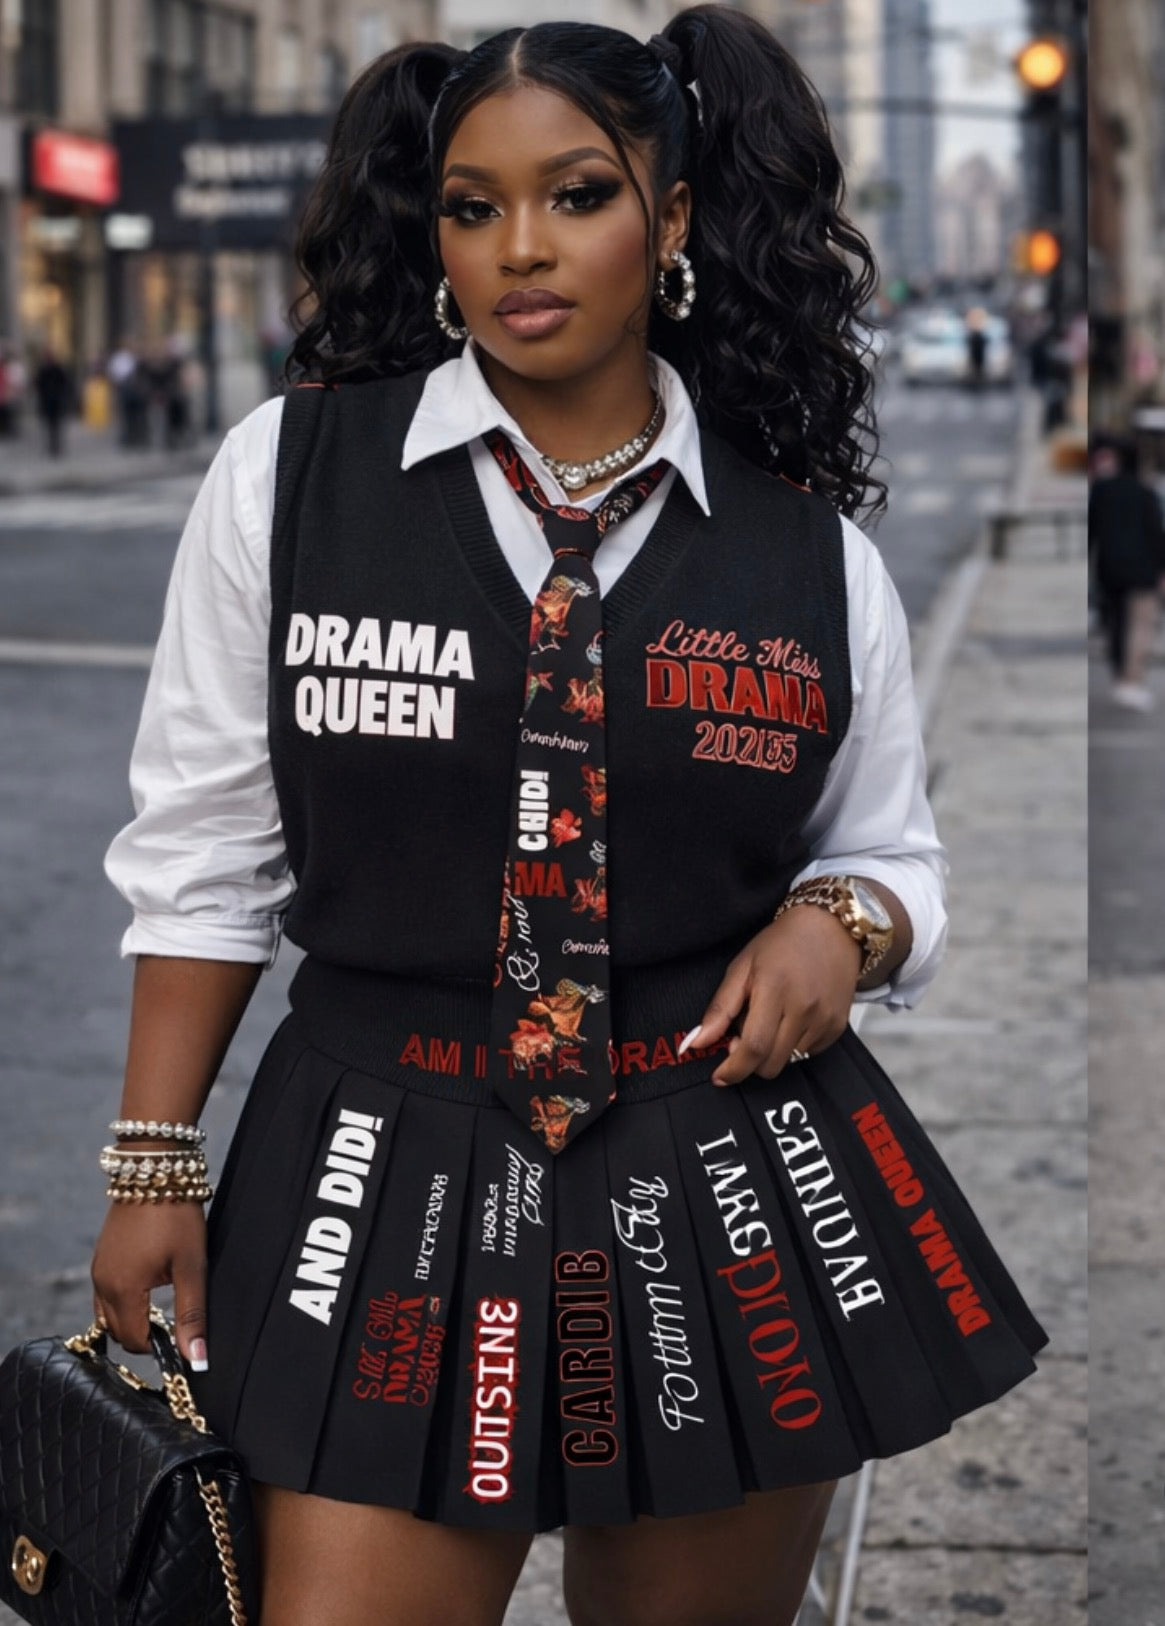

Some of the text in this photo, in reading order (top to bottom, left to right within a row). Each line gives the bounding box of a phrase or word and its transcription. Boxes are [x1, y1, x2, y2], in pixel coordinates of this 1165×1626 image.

[285, 613, 475, 681] DRAMA
[646, 619, 821, 679] Little Miss
[295, 675, 455, 740] QUEEN
[646, 658, 827, 734] DRAMA
[400, 1033, 460, 1076] AM
[474, 1045, 487, 1078] I
[289, 1108, 384, 1326] AND DID!
[852, 1100, 991, 1337] DRAMA QUEEN
